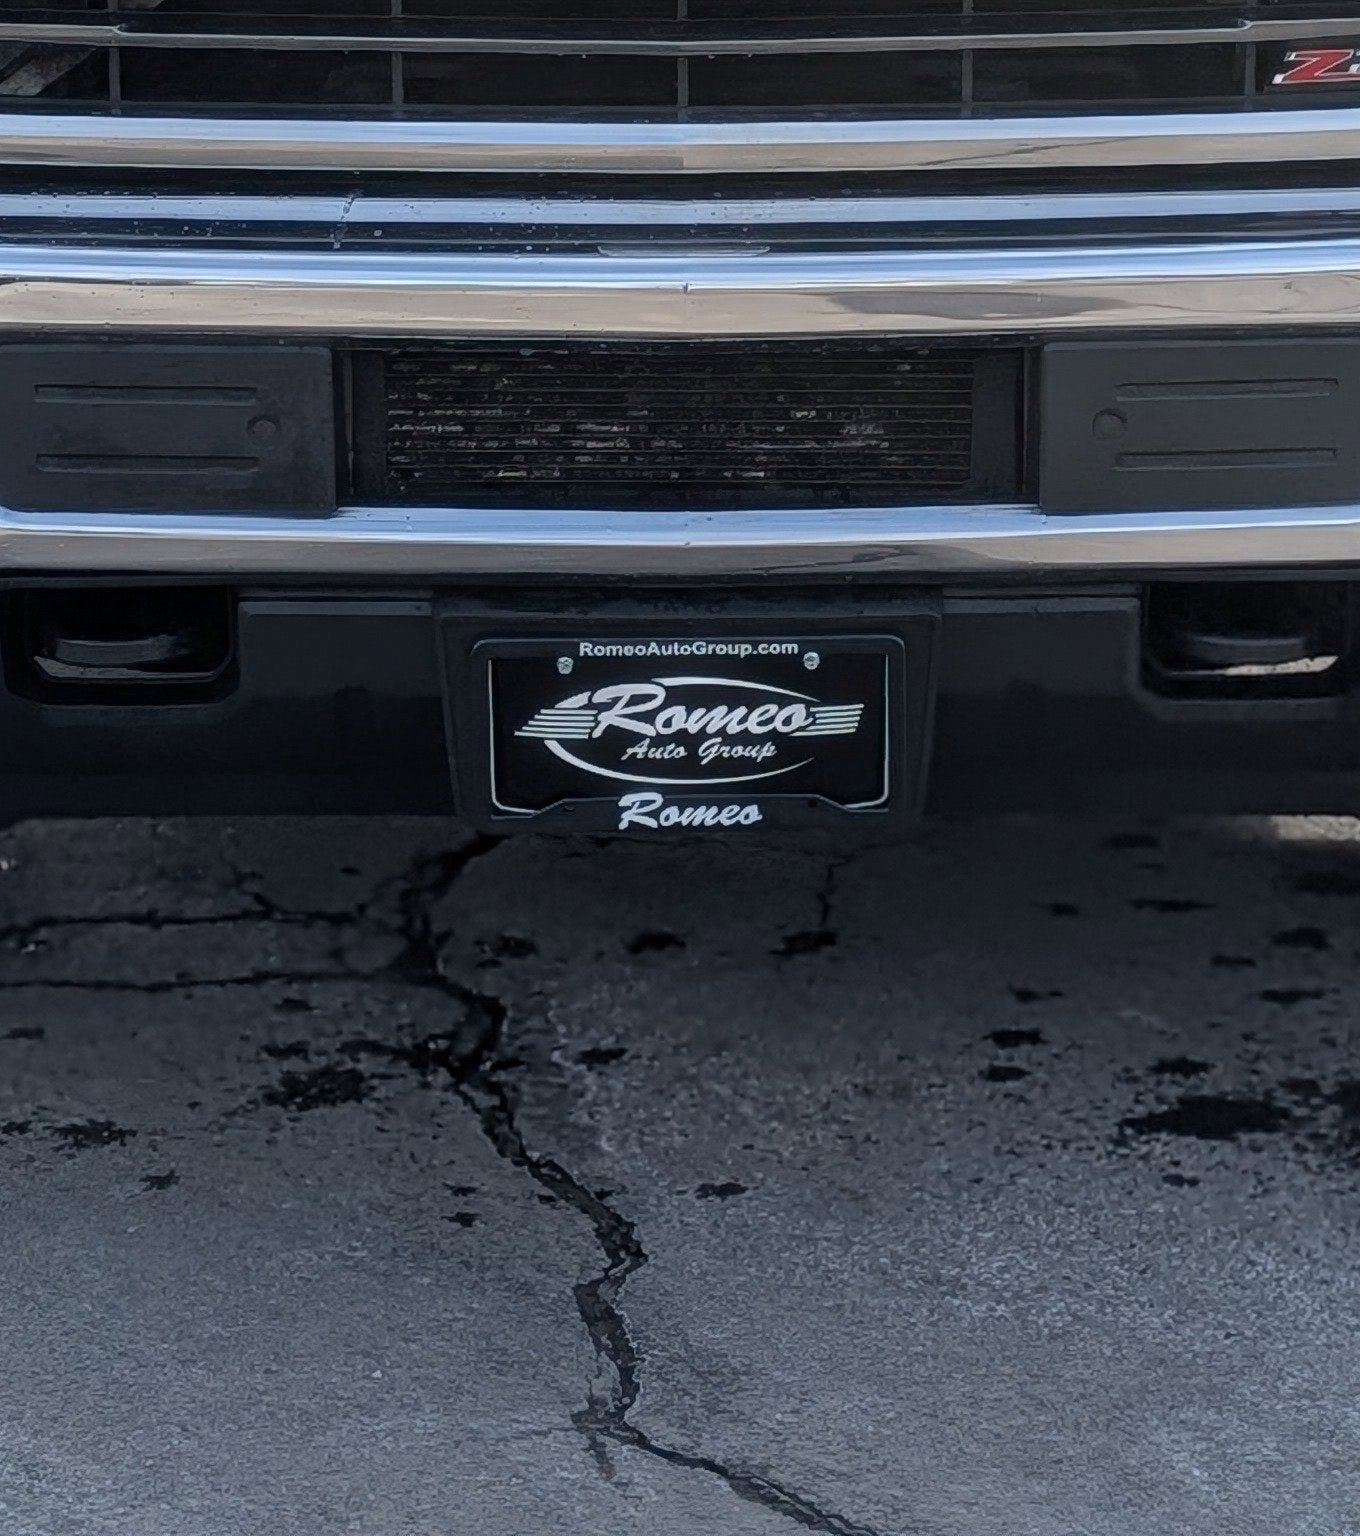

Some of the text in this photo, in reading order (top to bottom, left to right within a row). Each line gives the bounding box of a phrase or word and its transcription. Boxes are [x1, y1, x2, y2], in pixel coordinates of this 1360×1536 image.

[579, 641, 798, 658] RomeoAutoGroup.com
[592, 683, 812, 737] Romeo
[621, 737, 778, 765] Auto Group
[618, 791, 763, 830] Romeo
